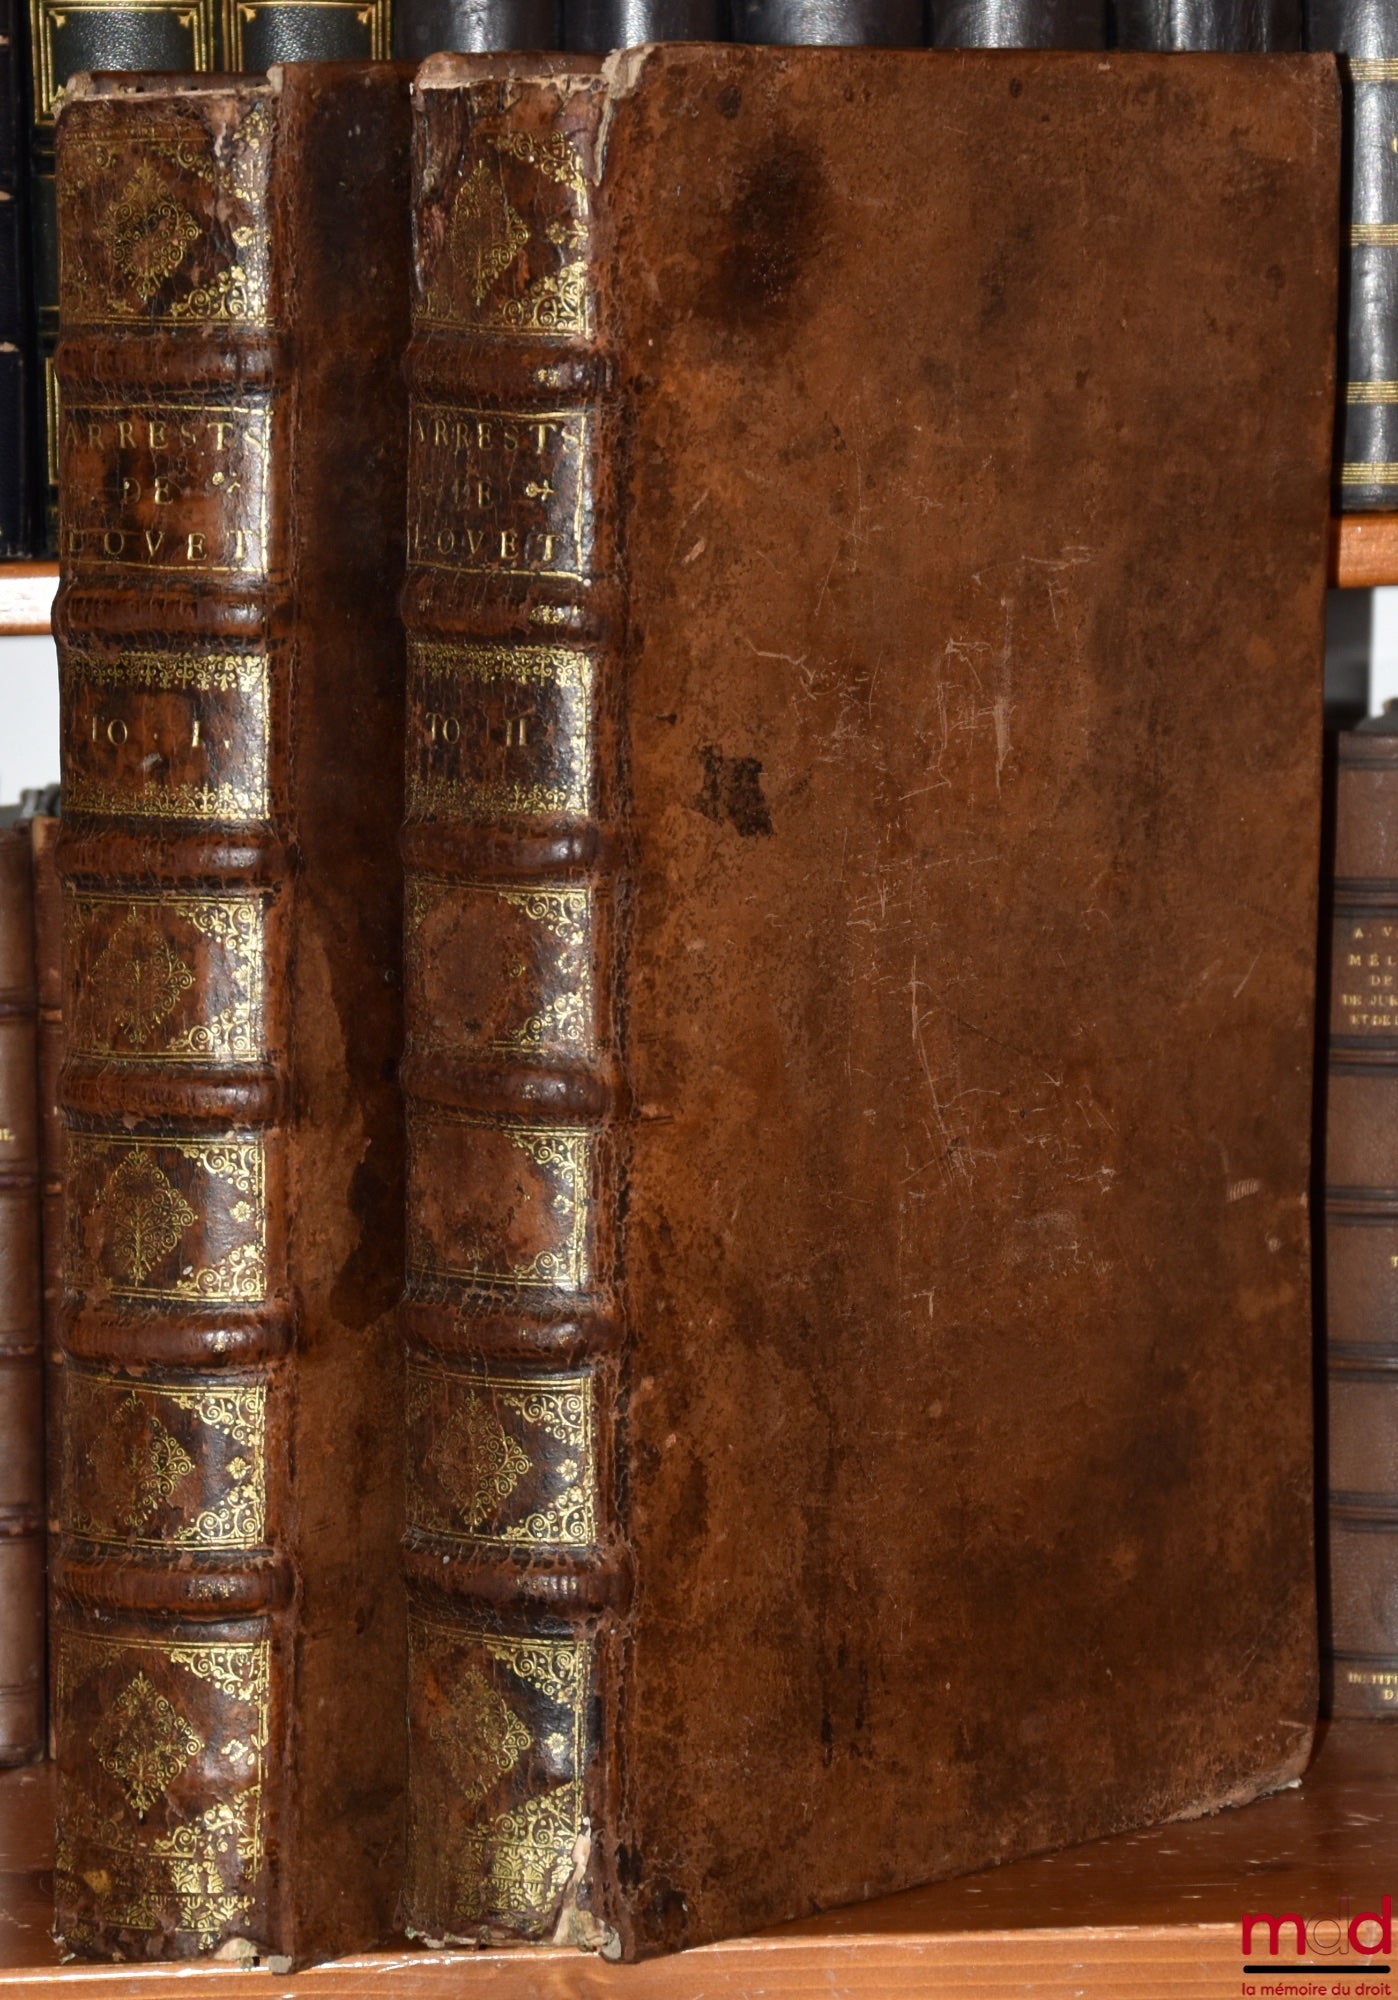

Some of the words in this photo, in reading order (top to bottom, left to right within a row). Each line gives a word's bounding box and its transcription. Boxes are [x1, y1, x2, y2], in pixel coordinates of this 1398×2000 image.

[64, 420, 263, 453] ARRESTS
[122, 475, 174, 505] DE
[425, 711, 460, 745] TO
[1370, 974, 1393, 986] DE
